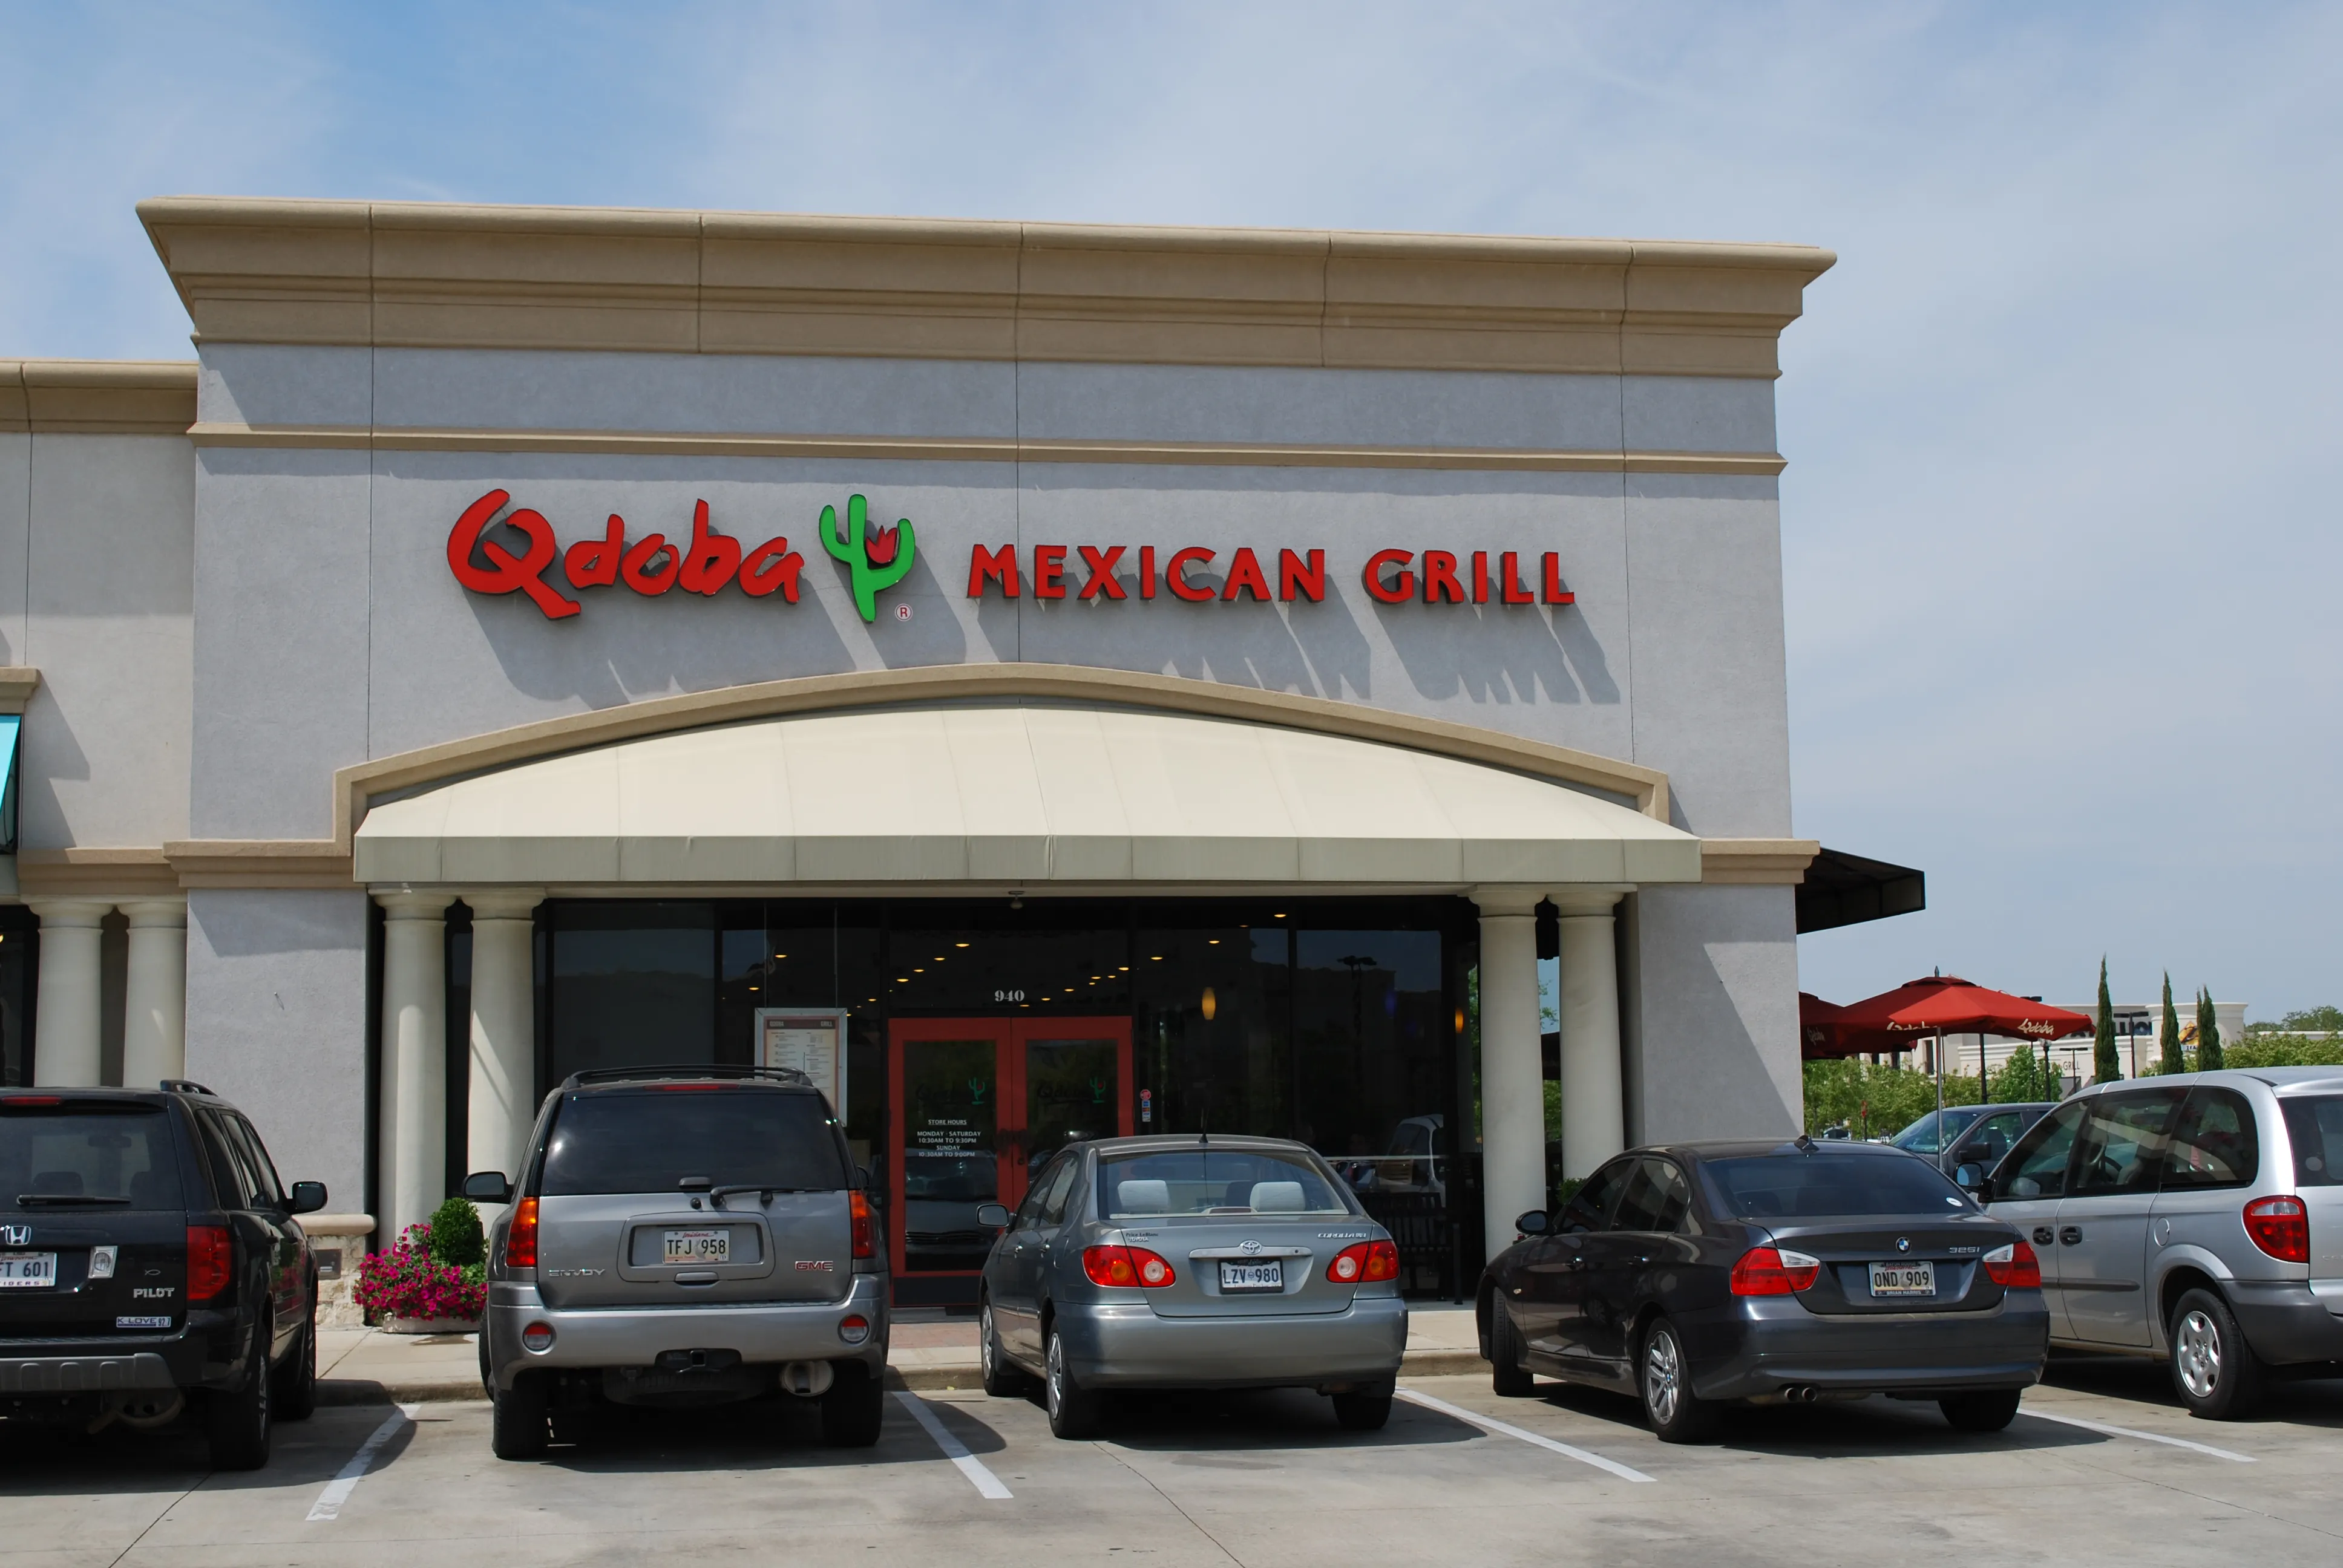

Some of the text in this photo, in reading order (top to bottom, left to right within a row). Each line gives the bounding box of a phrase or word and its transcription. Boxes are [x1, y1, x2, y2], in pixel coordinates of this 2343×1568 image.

[447, 489, 804, 619] Qdoba
[968, 544, 1574, 604] MEXICAN GRILL
[995, 990, 1024, 1002] 940
[2017, 1018, 2054, 1036] Qdoba
[667, 1239, 726, 1255] TFJ 958
[23, 1262, 48, 1278] 601
[548, 1269, 605, 1277] ENVOY
[795, 1260, 833, 1272] GMC
[1223, 1268, 1279, 1284] LZV 980
[1906, 1271, 1930, 1287] 909
[133, 1287, 175, 1298] PILOT
